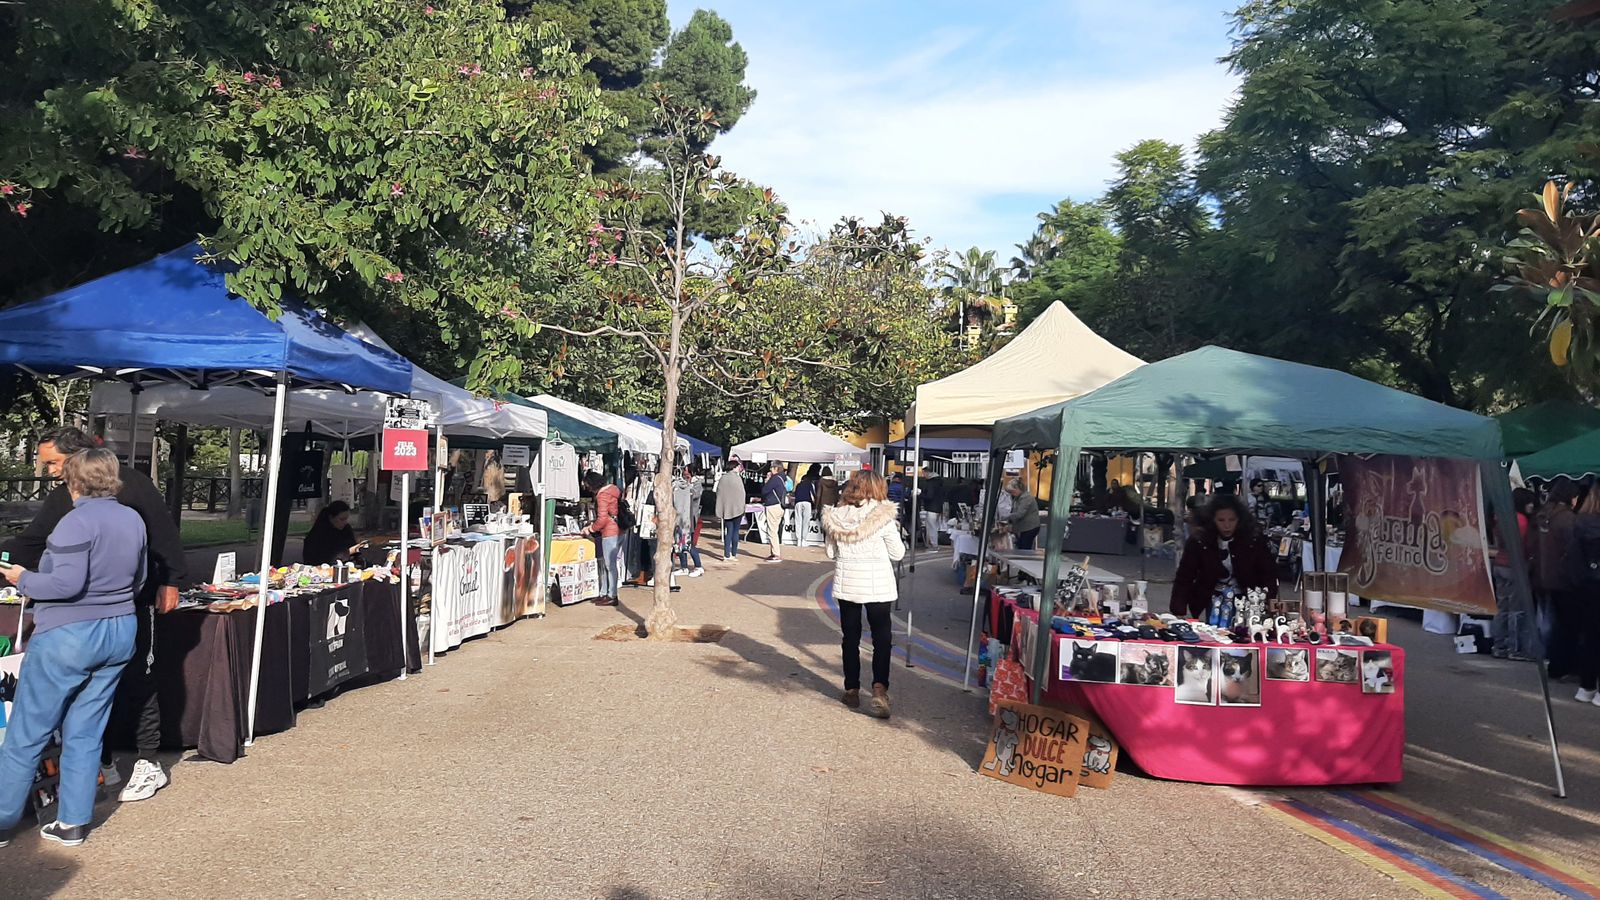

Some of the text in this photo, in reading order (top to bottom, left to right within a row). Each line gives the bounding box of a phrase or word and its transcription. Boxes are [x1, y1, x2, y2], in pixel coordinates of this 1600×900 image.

[394, 446, 417, 456] 2023
[1376, 544, 1422, 565] felino
[1018, 713, 1079, 744] HOGAR
[1022, 733, 1068, 764] DULCE
[1012, 743, 1073, 788] hogar
